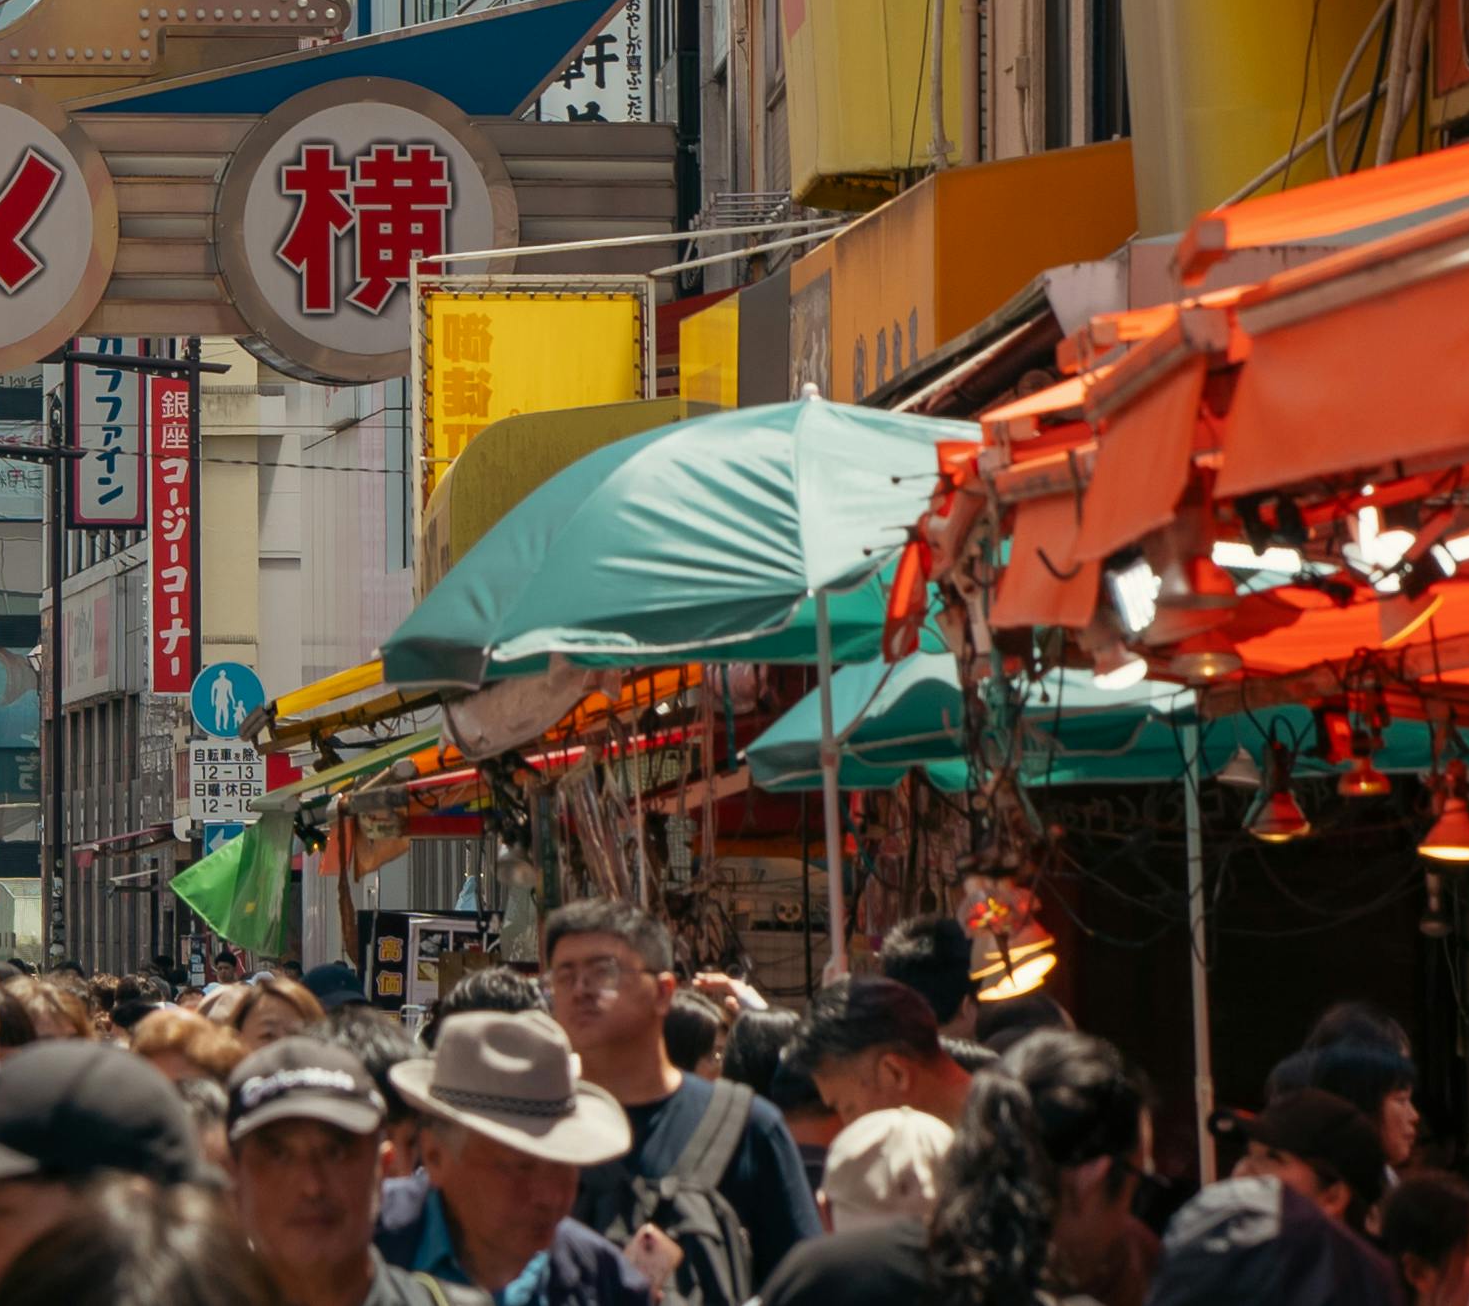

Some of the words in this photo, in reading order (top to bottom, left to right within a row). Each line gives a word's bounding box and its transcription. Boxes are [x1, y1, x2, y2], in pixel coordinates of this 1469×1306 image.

[159, 390, 191, 677] 銀座コージーコーナー
